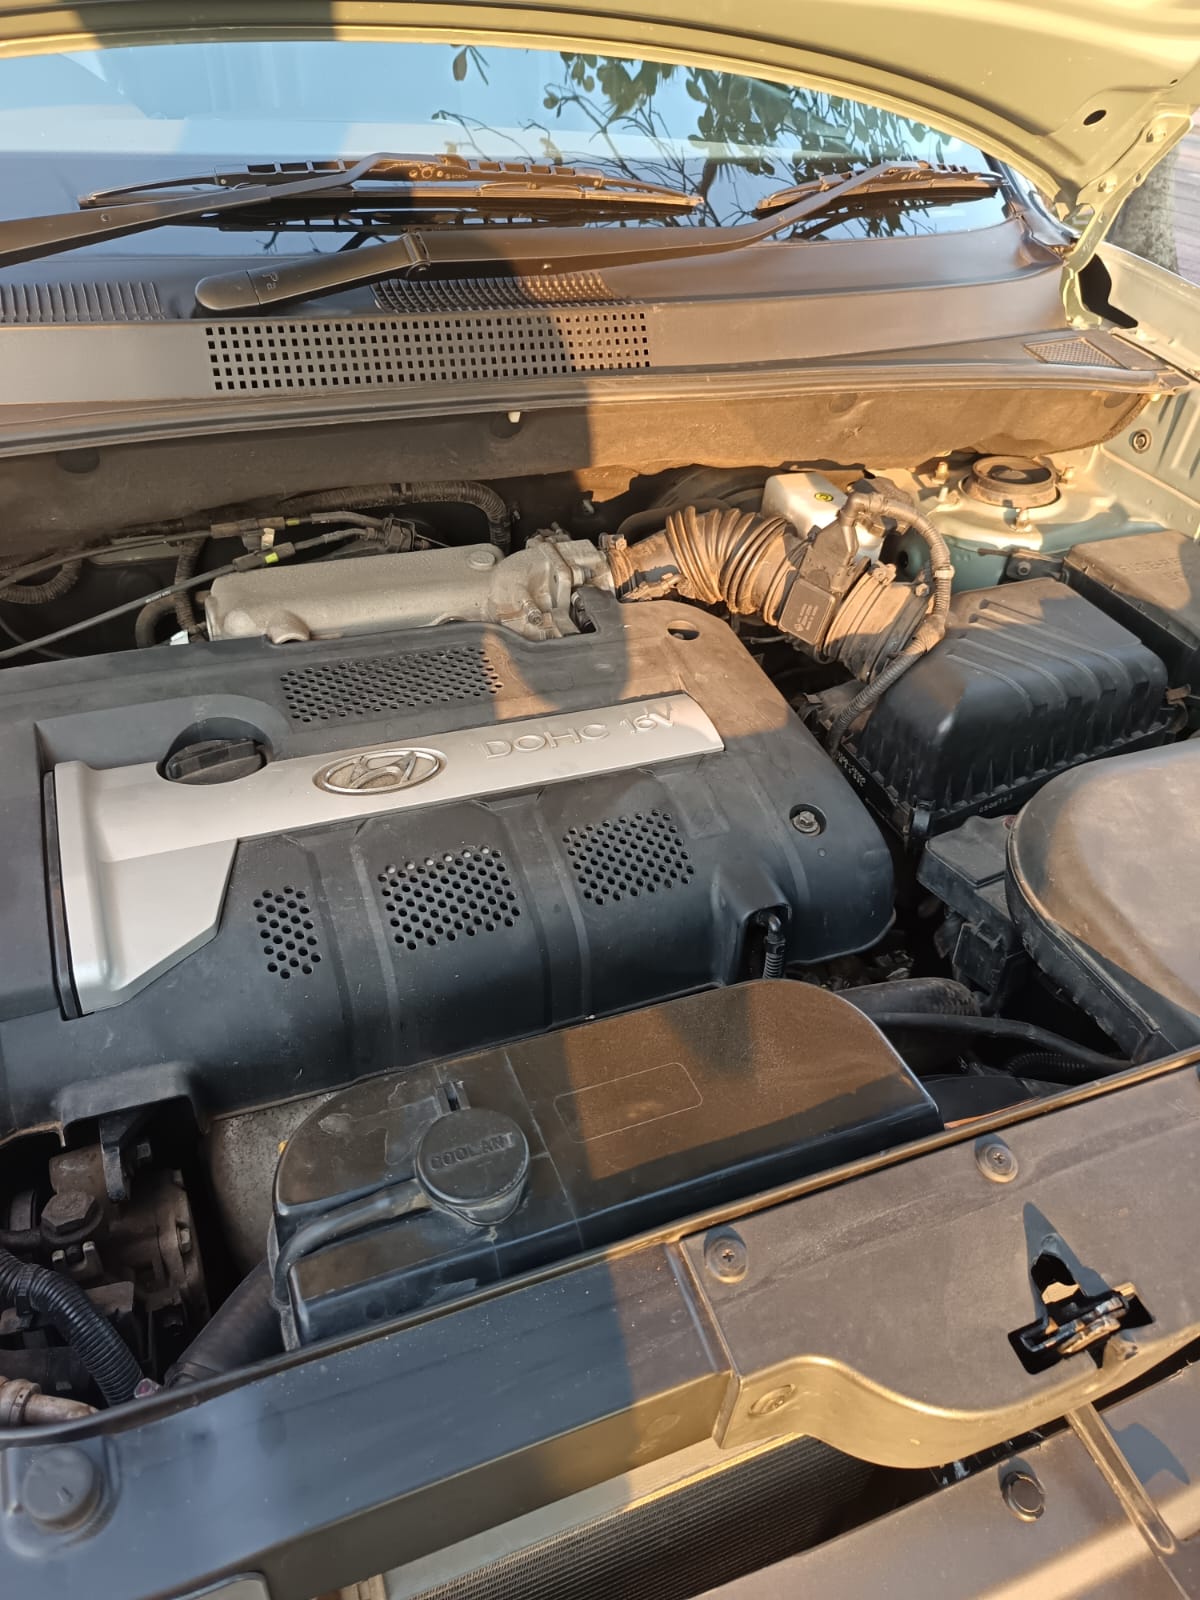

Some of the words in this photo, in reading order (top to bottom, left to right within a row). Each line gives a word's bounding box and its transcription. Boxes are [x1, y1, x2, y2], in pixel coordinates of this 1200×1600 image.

[482, 723, 609, 760] DOHC
[619, 702, 674, 734] 16V
[430, 1131, 514, 1172] COOLANT
